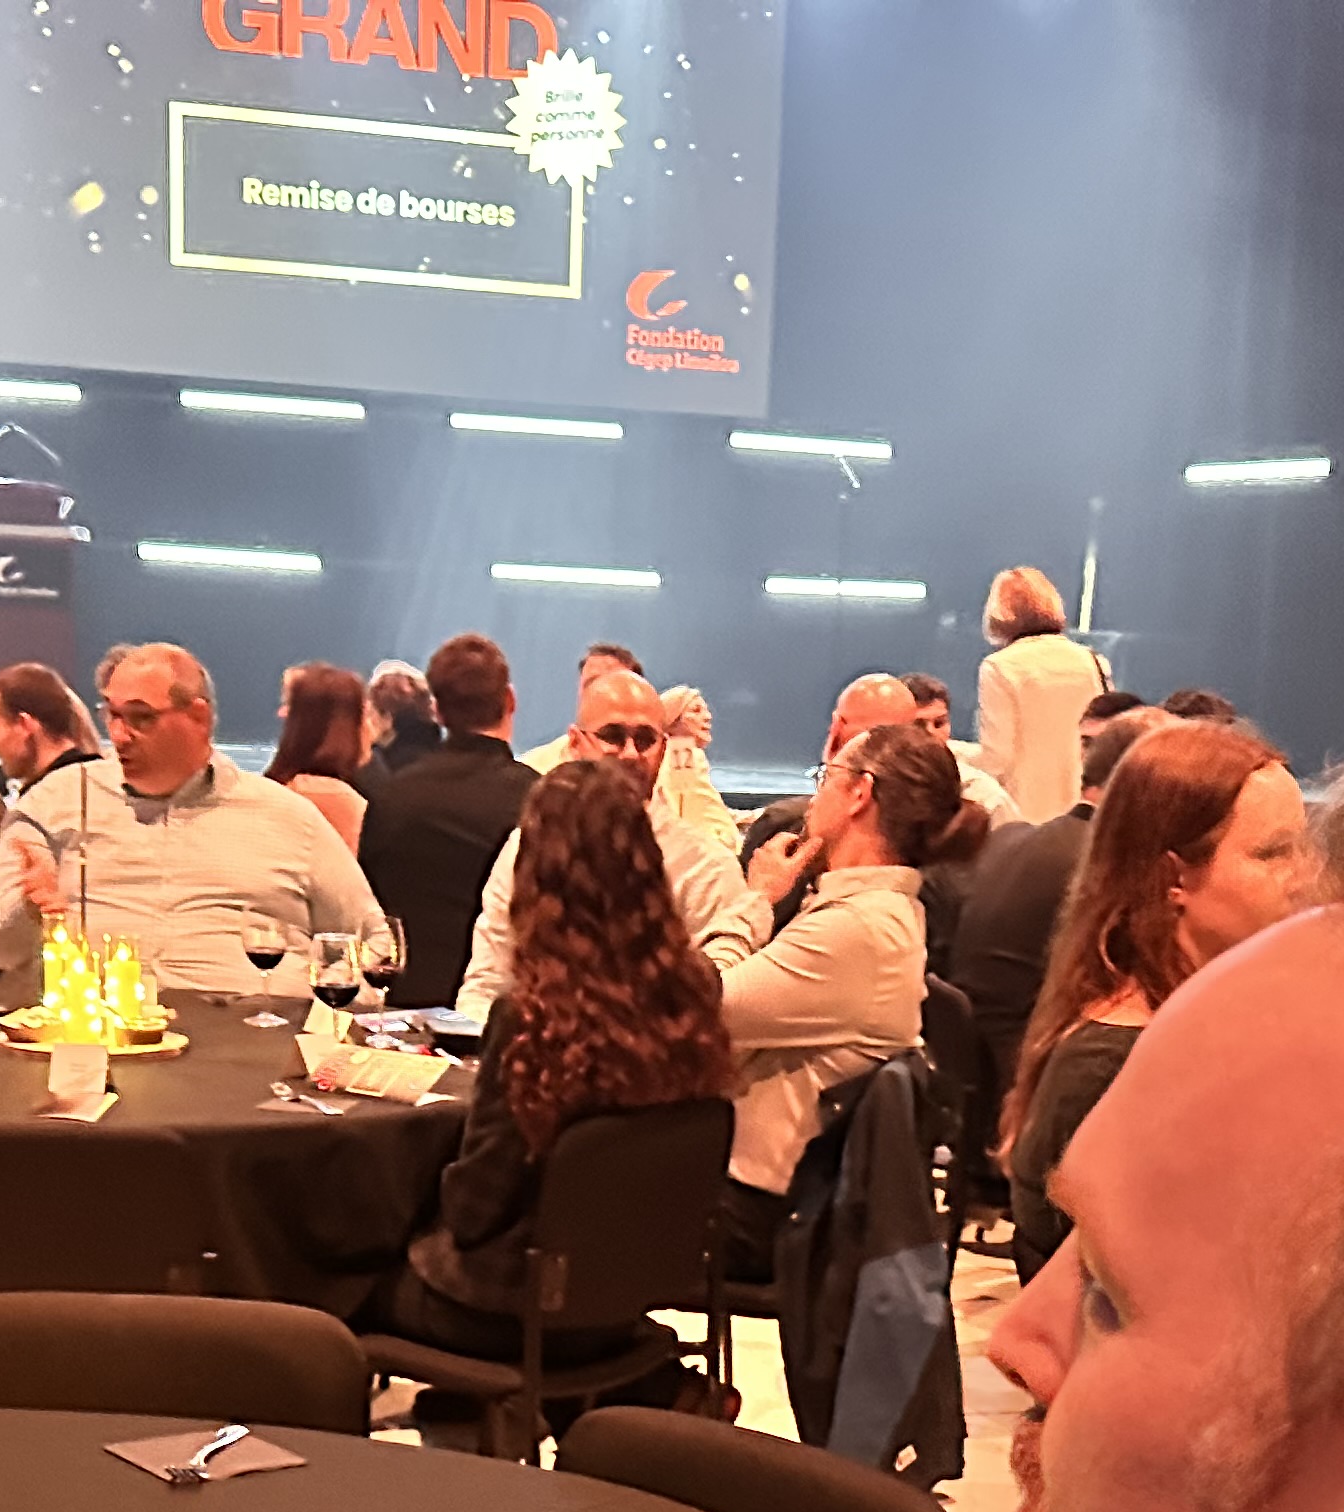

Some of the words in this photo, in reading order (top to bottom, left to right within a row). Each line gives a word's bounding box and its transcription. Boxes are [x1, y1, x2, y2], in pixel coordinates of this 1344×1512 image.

[201, 0, 558, 80] GRAND
[241, 176, 354, 213] Remise
[356, 186, 396, 218] de
[399, 189, 517, 229] bourses
[625, 322, 725, 353] Fondation
